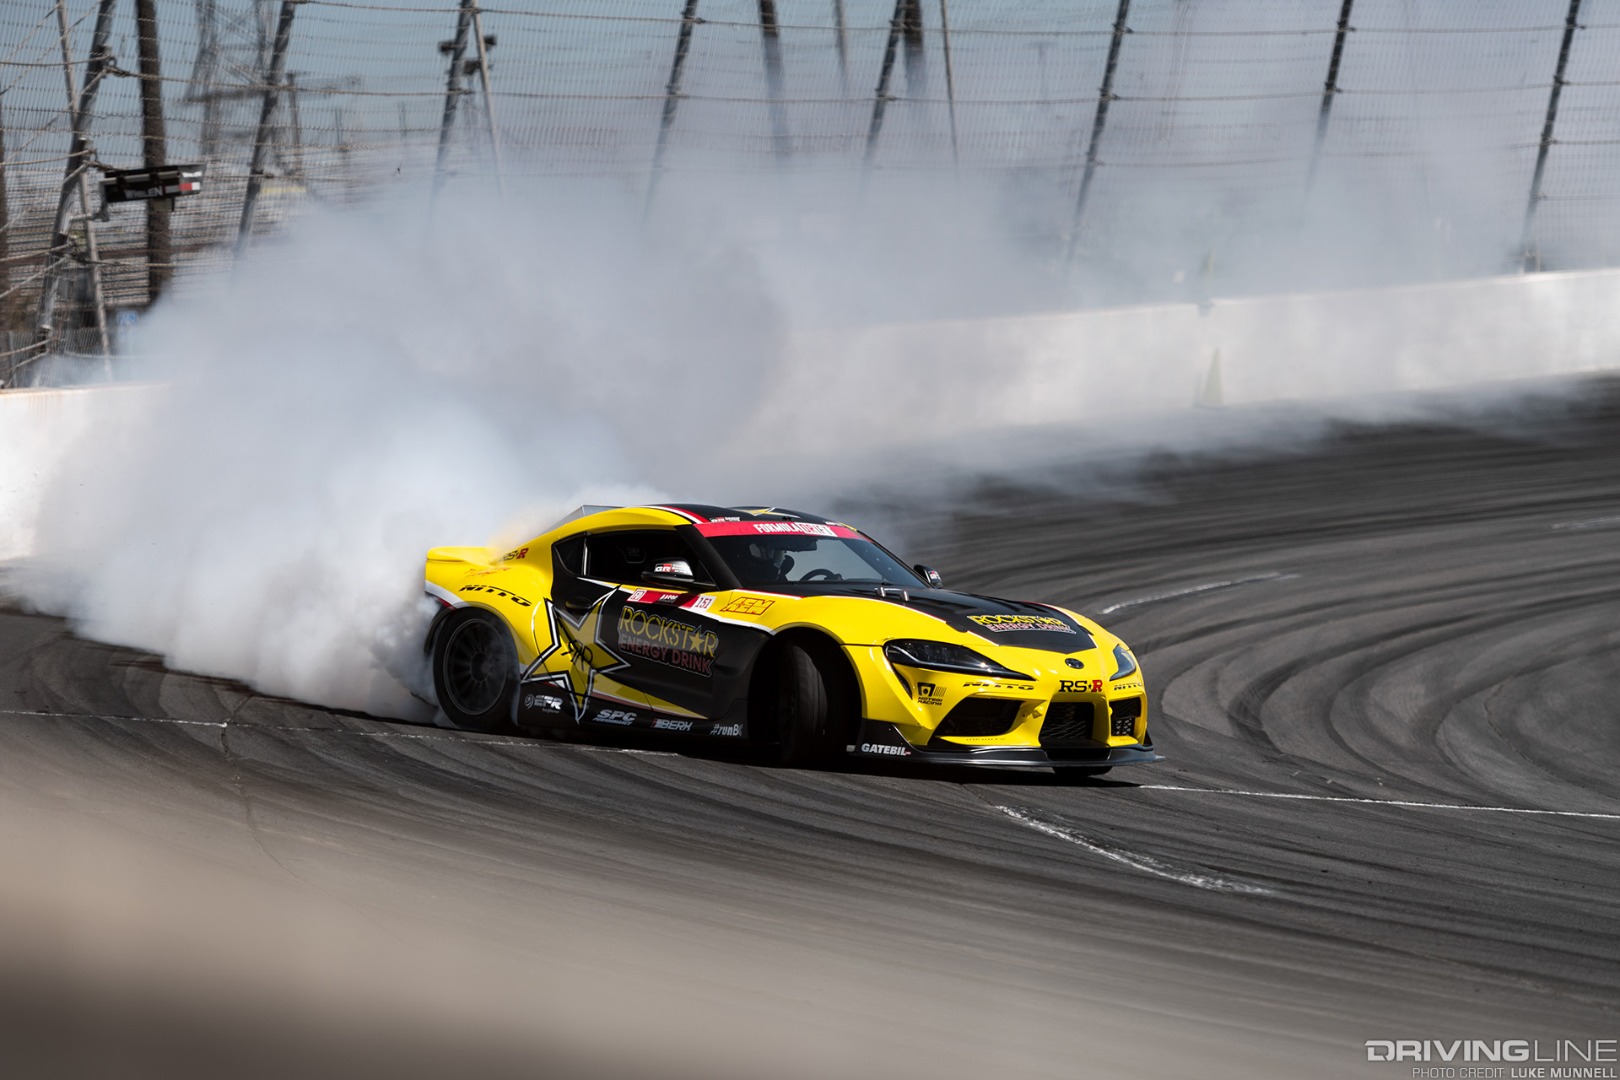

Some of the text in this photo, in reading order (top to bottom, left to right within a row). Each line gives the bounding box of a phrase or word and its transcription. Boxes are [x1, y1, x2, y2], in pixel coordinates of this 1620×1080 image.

[753, 523, 801, 534] FORMULA
[459, 585, 532, 607] NITTO
[695, 597, 713, 609] 151
[719, 596, 776, 616] AEM
[620, 634, 669, 660] ENERGY
[672, 648, 711, 674] DRINK
[963, 681, 1034, 691] NITTO
[597, 709, 637, 721] SPC
[861, 743, 907, 756] GATEBIL
